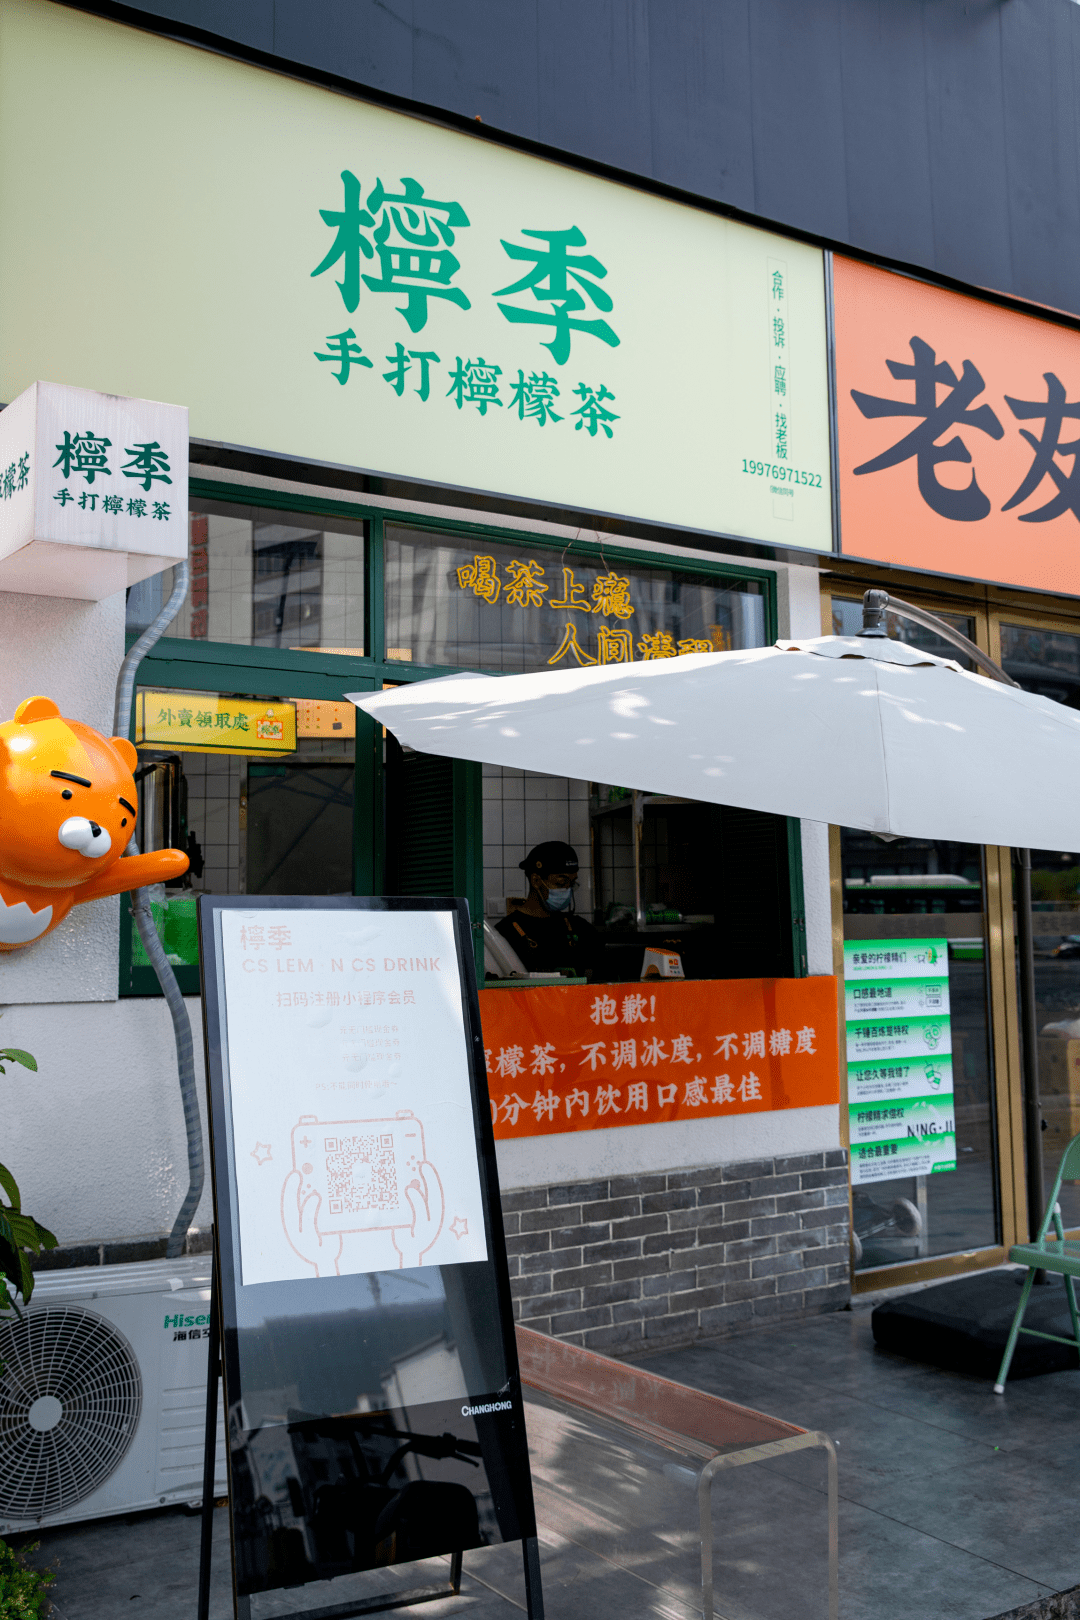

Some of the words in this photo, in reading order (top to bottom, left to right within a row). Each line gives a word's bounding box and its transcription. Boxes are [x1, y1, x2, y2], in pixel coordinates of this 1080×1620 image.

[310, 169, 620, 366] 檸季
[313, 327, 621, 439] 手打檸檬茶
[52, 430, 173, 492] 檸季
[741, 458, 823, 489] 19976971522
[52, 487, 172, 521] 手打檸檬茶
[157, 707, 251, 732] 外賣領取處
[241, 958, 269, 973] CS
[351, 957, 377, 973] CS
[383, 957, 442, 972] DRINK
[276, 989, 416, 1008] 扫码注册小程序会员
[461, 1400, 512, 1417] CHANGHONG
